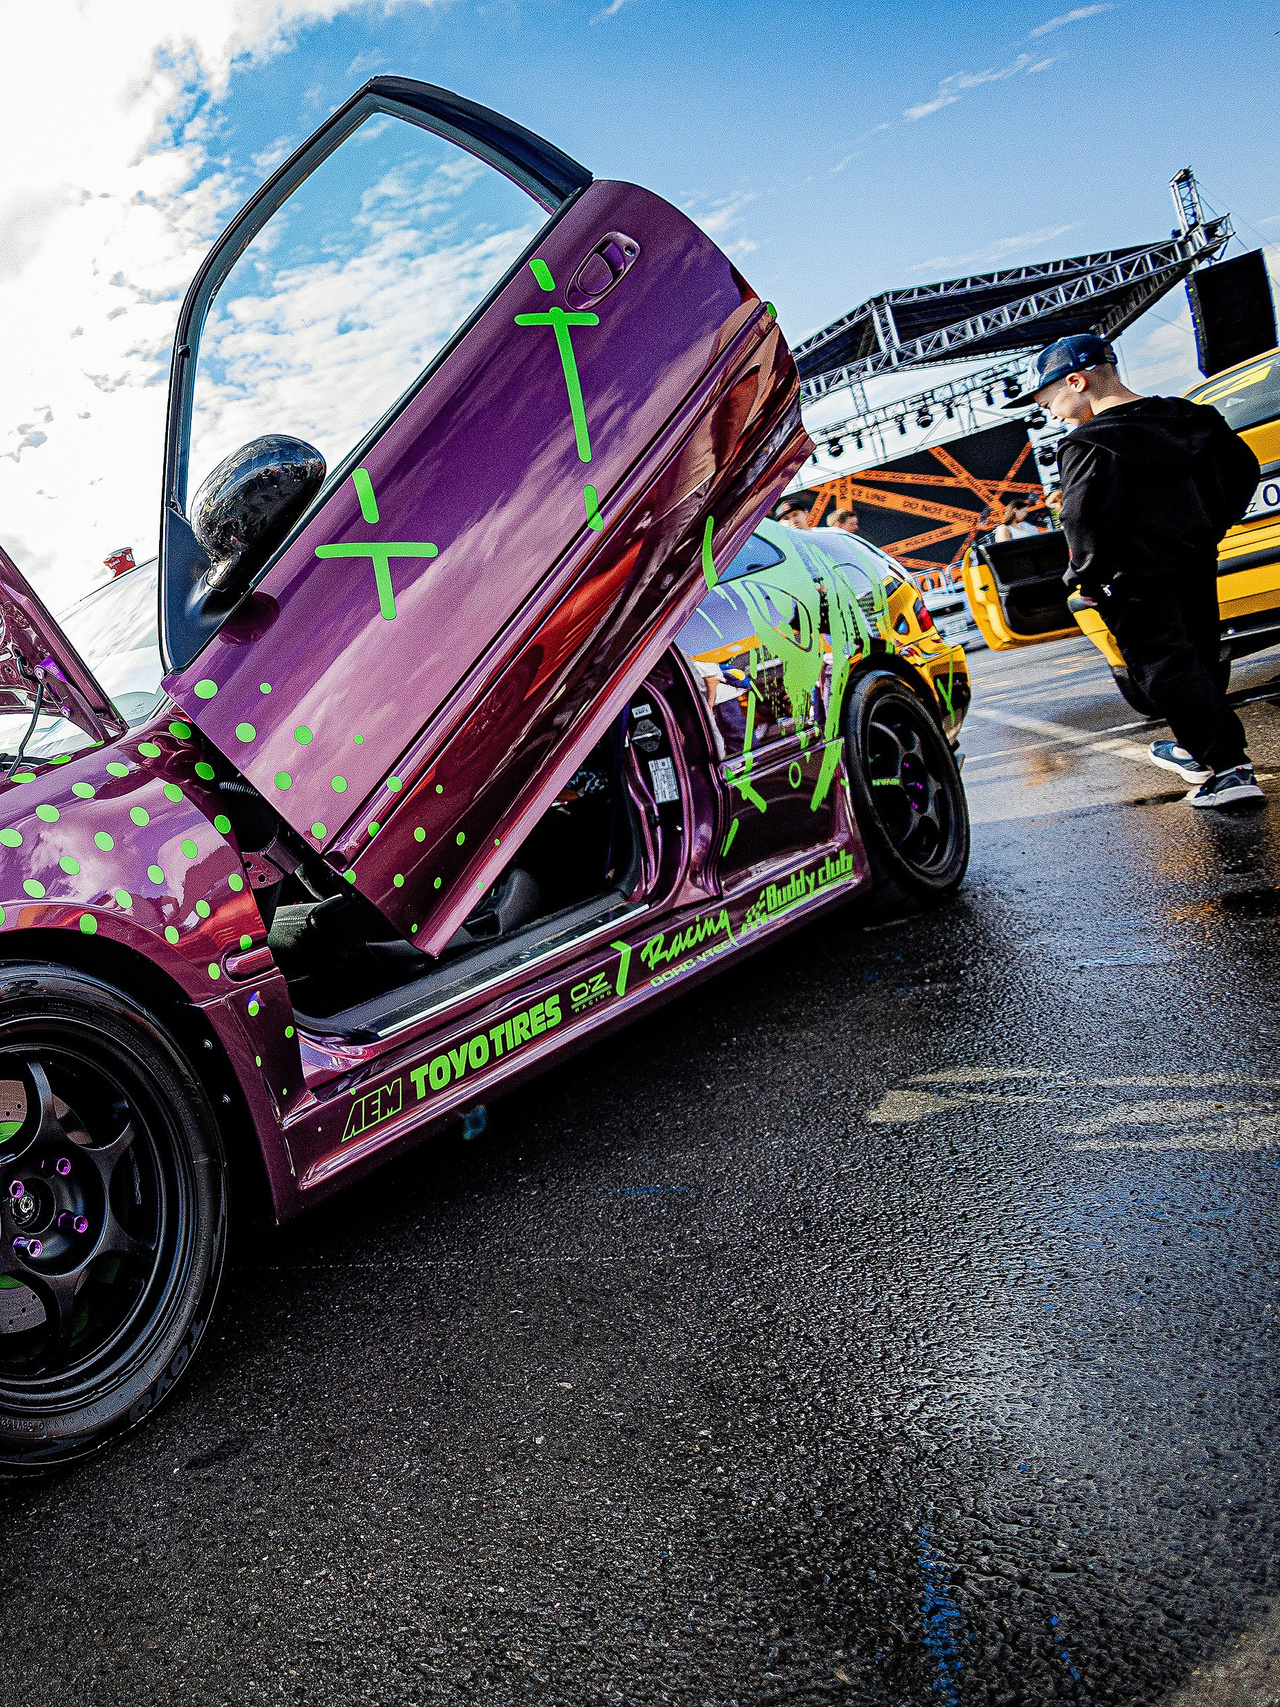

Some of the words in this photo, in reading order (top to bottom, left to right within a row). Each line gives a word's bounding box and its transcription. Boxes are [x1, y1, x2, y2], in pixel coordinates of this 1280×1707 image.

[766, 868, 816, 912] Buddy
[818, 848, 854, 885] club
[640, 908, 740, 971] Racing
[410, 1033, 490, 1100] TOYO
[488, 993, 563, 1057] TIRES
[341, 1077, 403, 1142] AEM
[128, 1319, 204, 1423] TOYO
